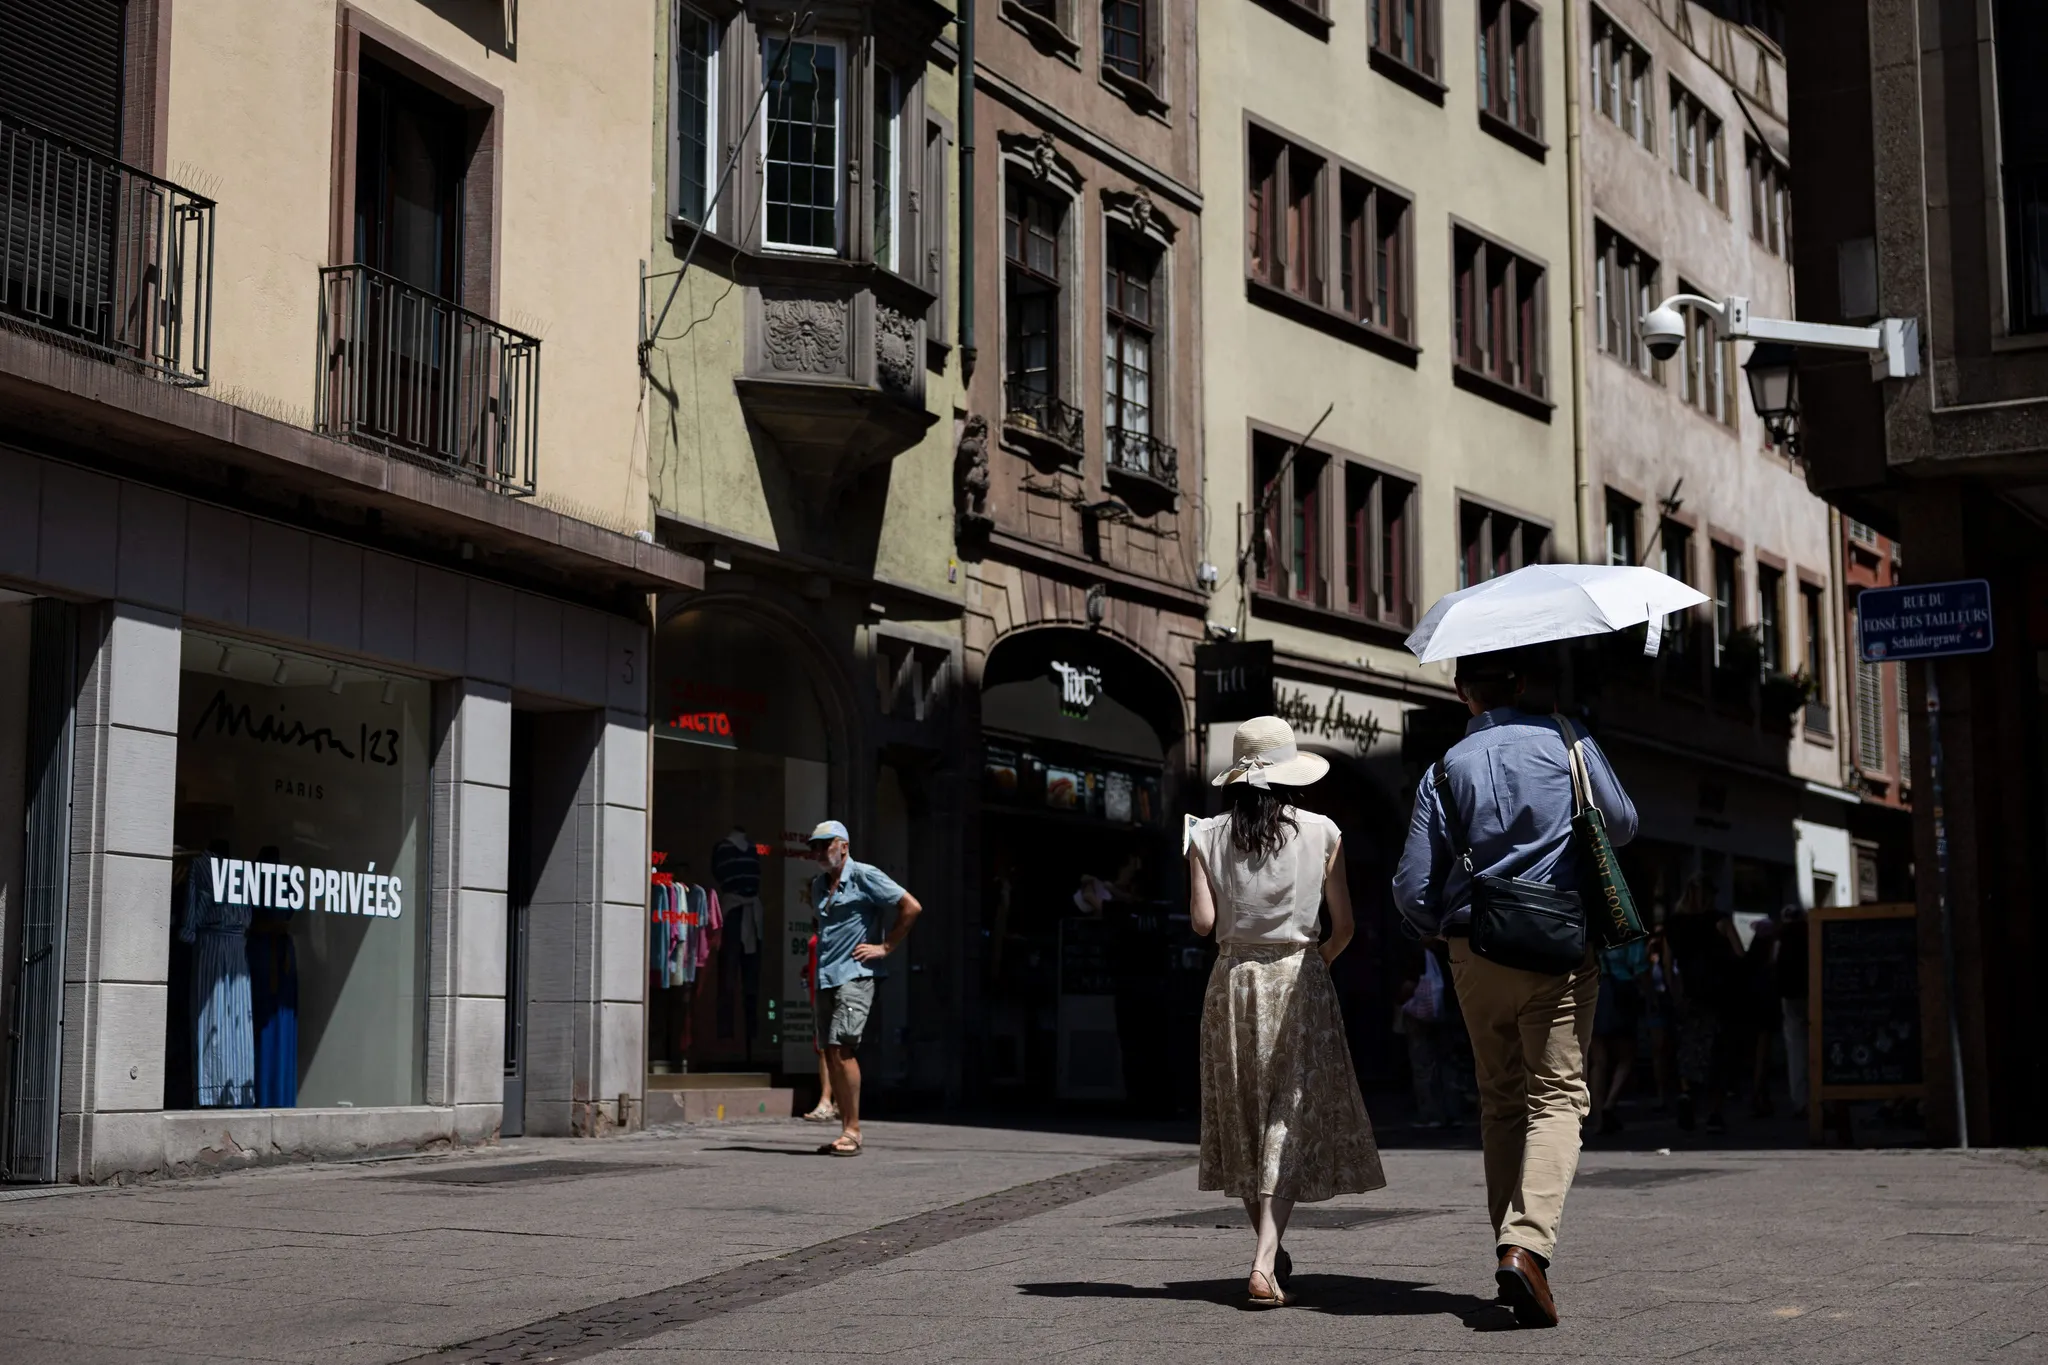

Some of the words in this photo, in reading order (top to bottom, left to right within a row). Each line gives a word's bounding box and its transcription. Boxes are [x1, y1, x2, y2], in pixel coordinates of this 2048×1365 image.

[1903, 593, 1927, 610] RUE
[1928, 592, 1945, 607] DU
[1863, 612, 1899, 633] FOSSÉ
[1901, 614, 1923, 630] DES
[1924, 608, 1989, 627] TAILLEURS
[622, 647, 634, 685] 3
[193, 689, 355, 760] Maison
[275, 779, 324, 800] PARIS
[211, 856, 305, 910] VENTES
[309, 861, 402, 919] PRIVÉES
[1587, 824, 1612, 878] DAUNT
[1604, 884, 1632, 939] BOOKS
